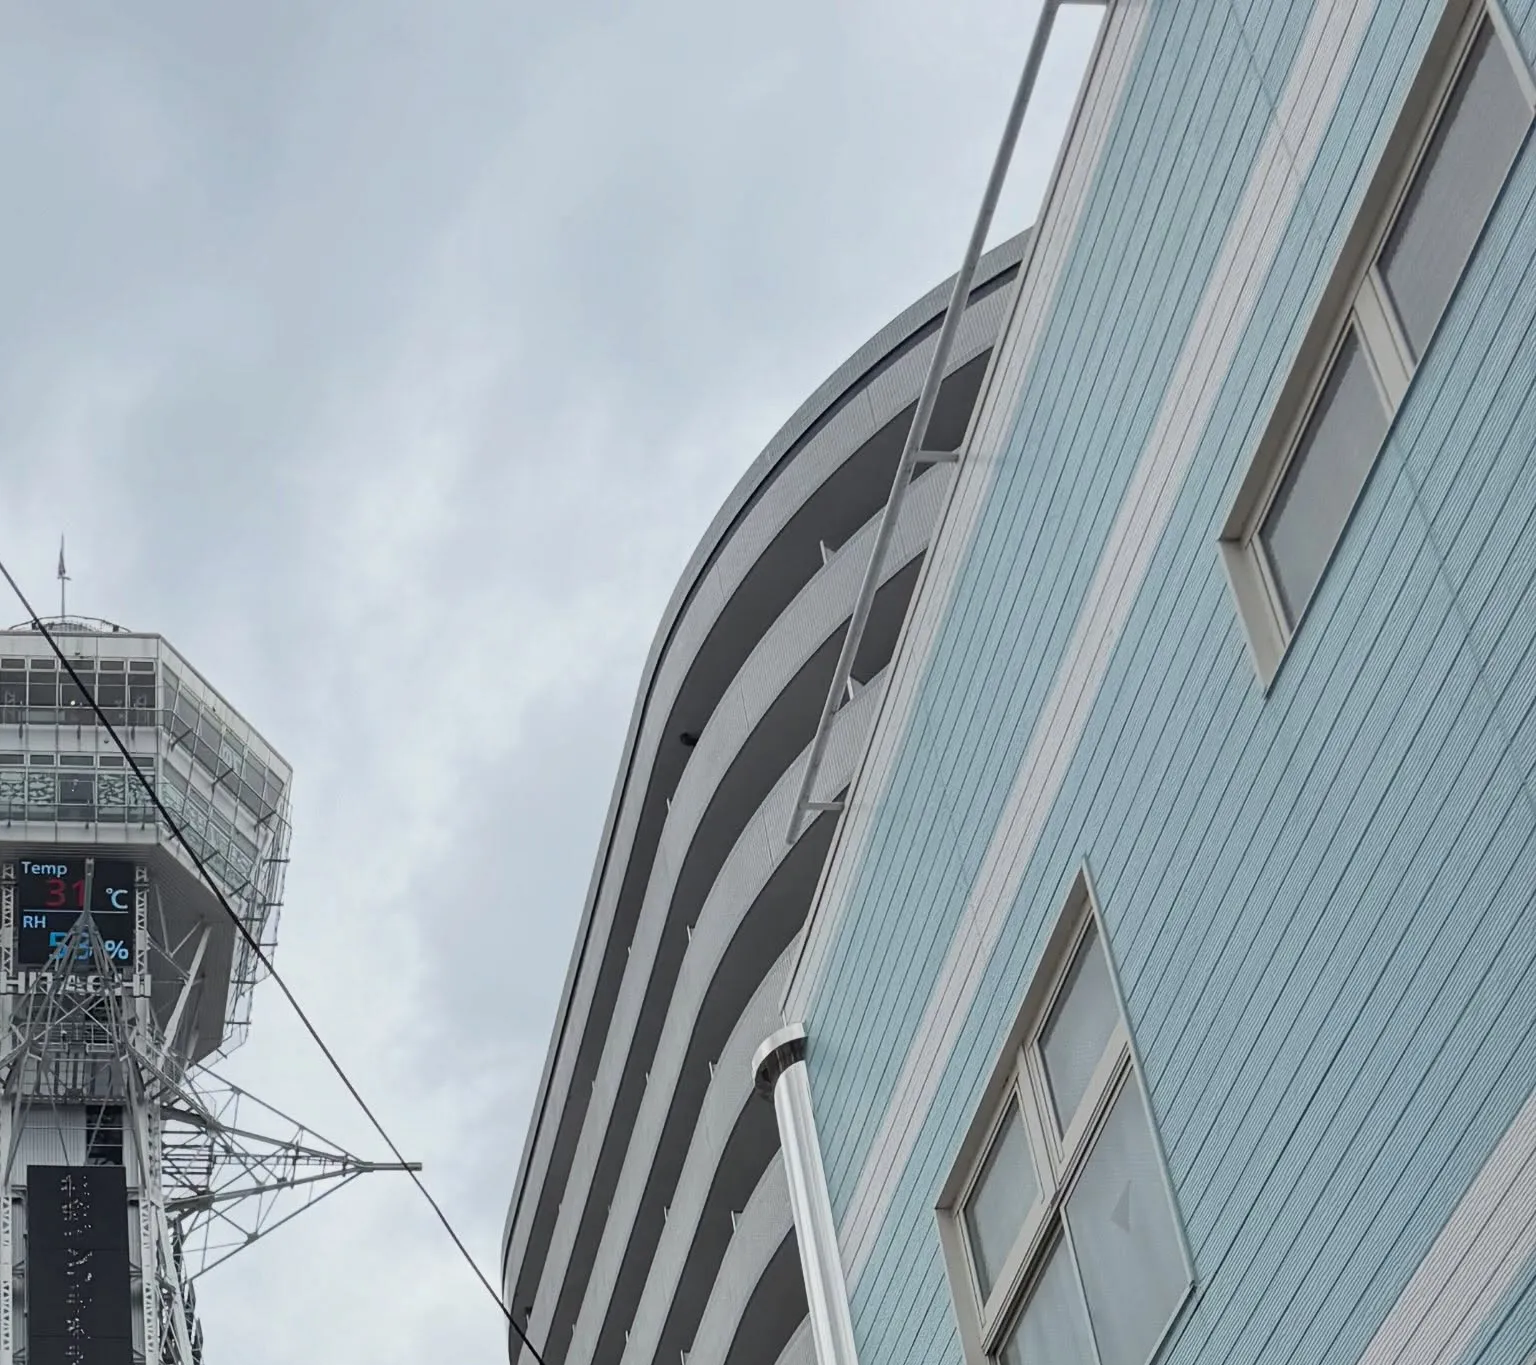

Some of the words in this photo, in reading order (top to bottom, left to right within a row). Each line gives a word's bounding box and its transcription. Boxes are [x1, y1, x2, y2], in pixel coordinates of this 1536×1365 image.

[22, 861, 67, 877] Temp
[23, 915, 46, 929] RH
[105, 939, 129, 960] %
